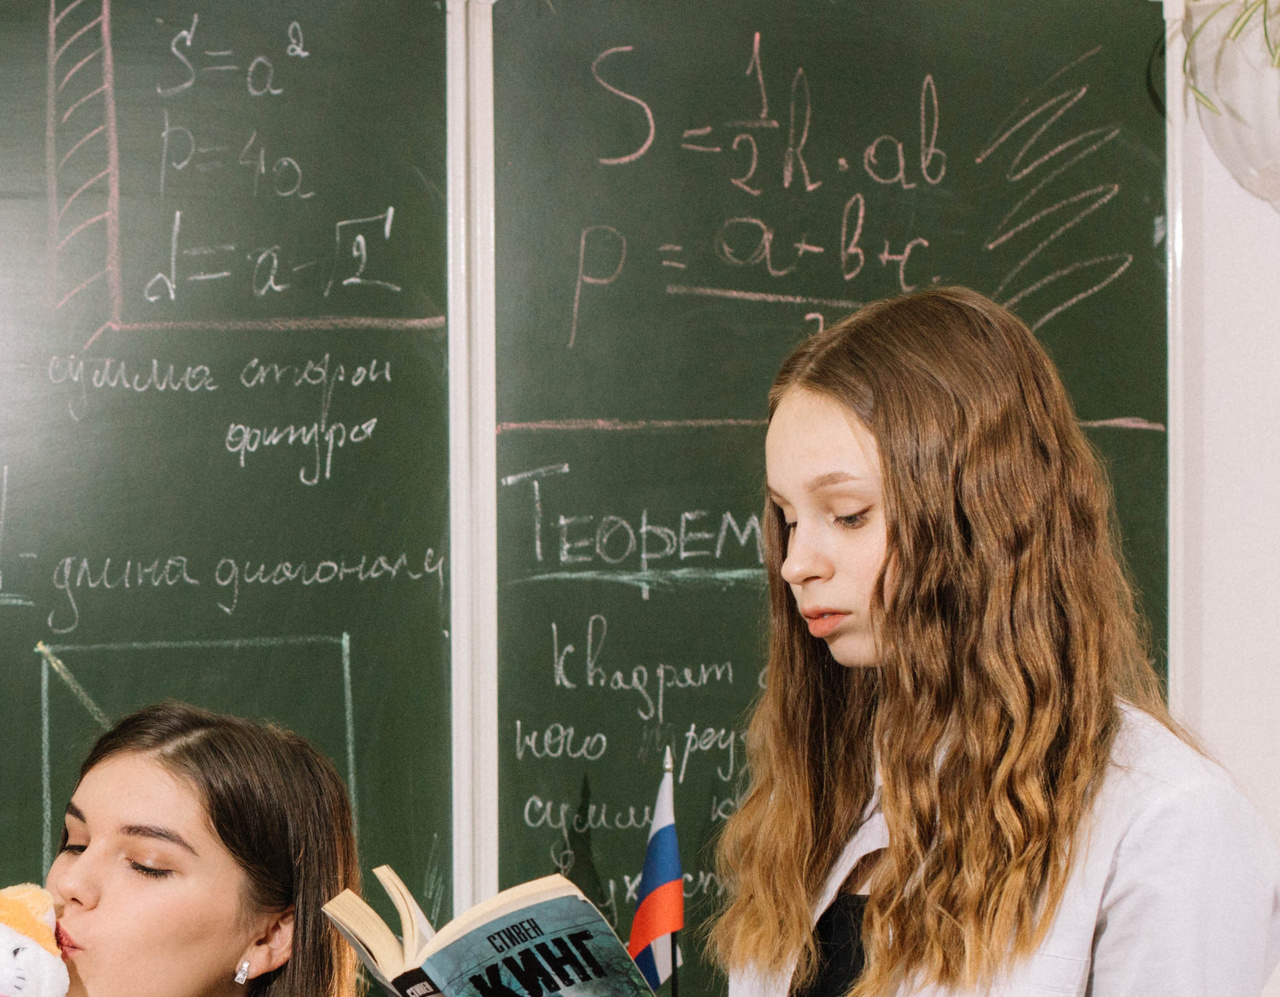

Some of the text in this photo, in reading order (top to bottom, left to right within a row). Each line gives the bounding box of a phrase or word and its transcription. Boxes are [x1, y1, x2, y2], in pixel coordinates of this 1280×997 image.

[501, 463, 765, 601] ТЕОРЕМ
[523, 794, 655, 870] сумм
[486, 917, 546, 954] СТИВЕН
